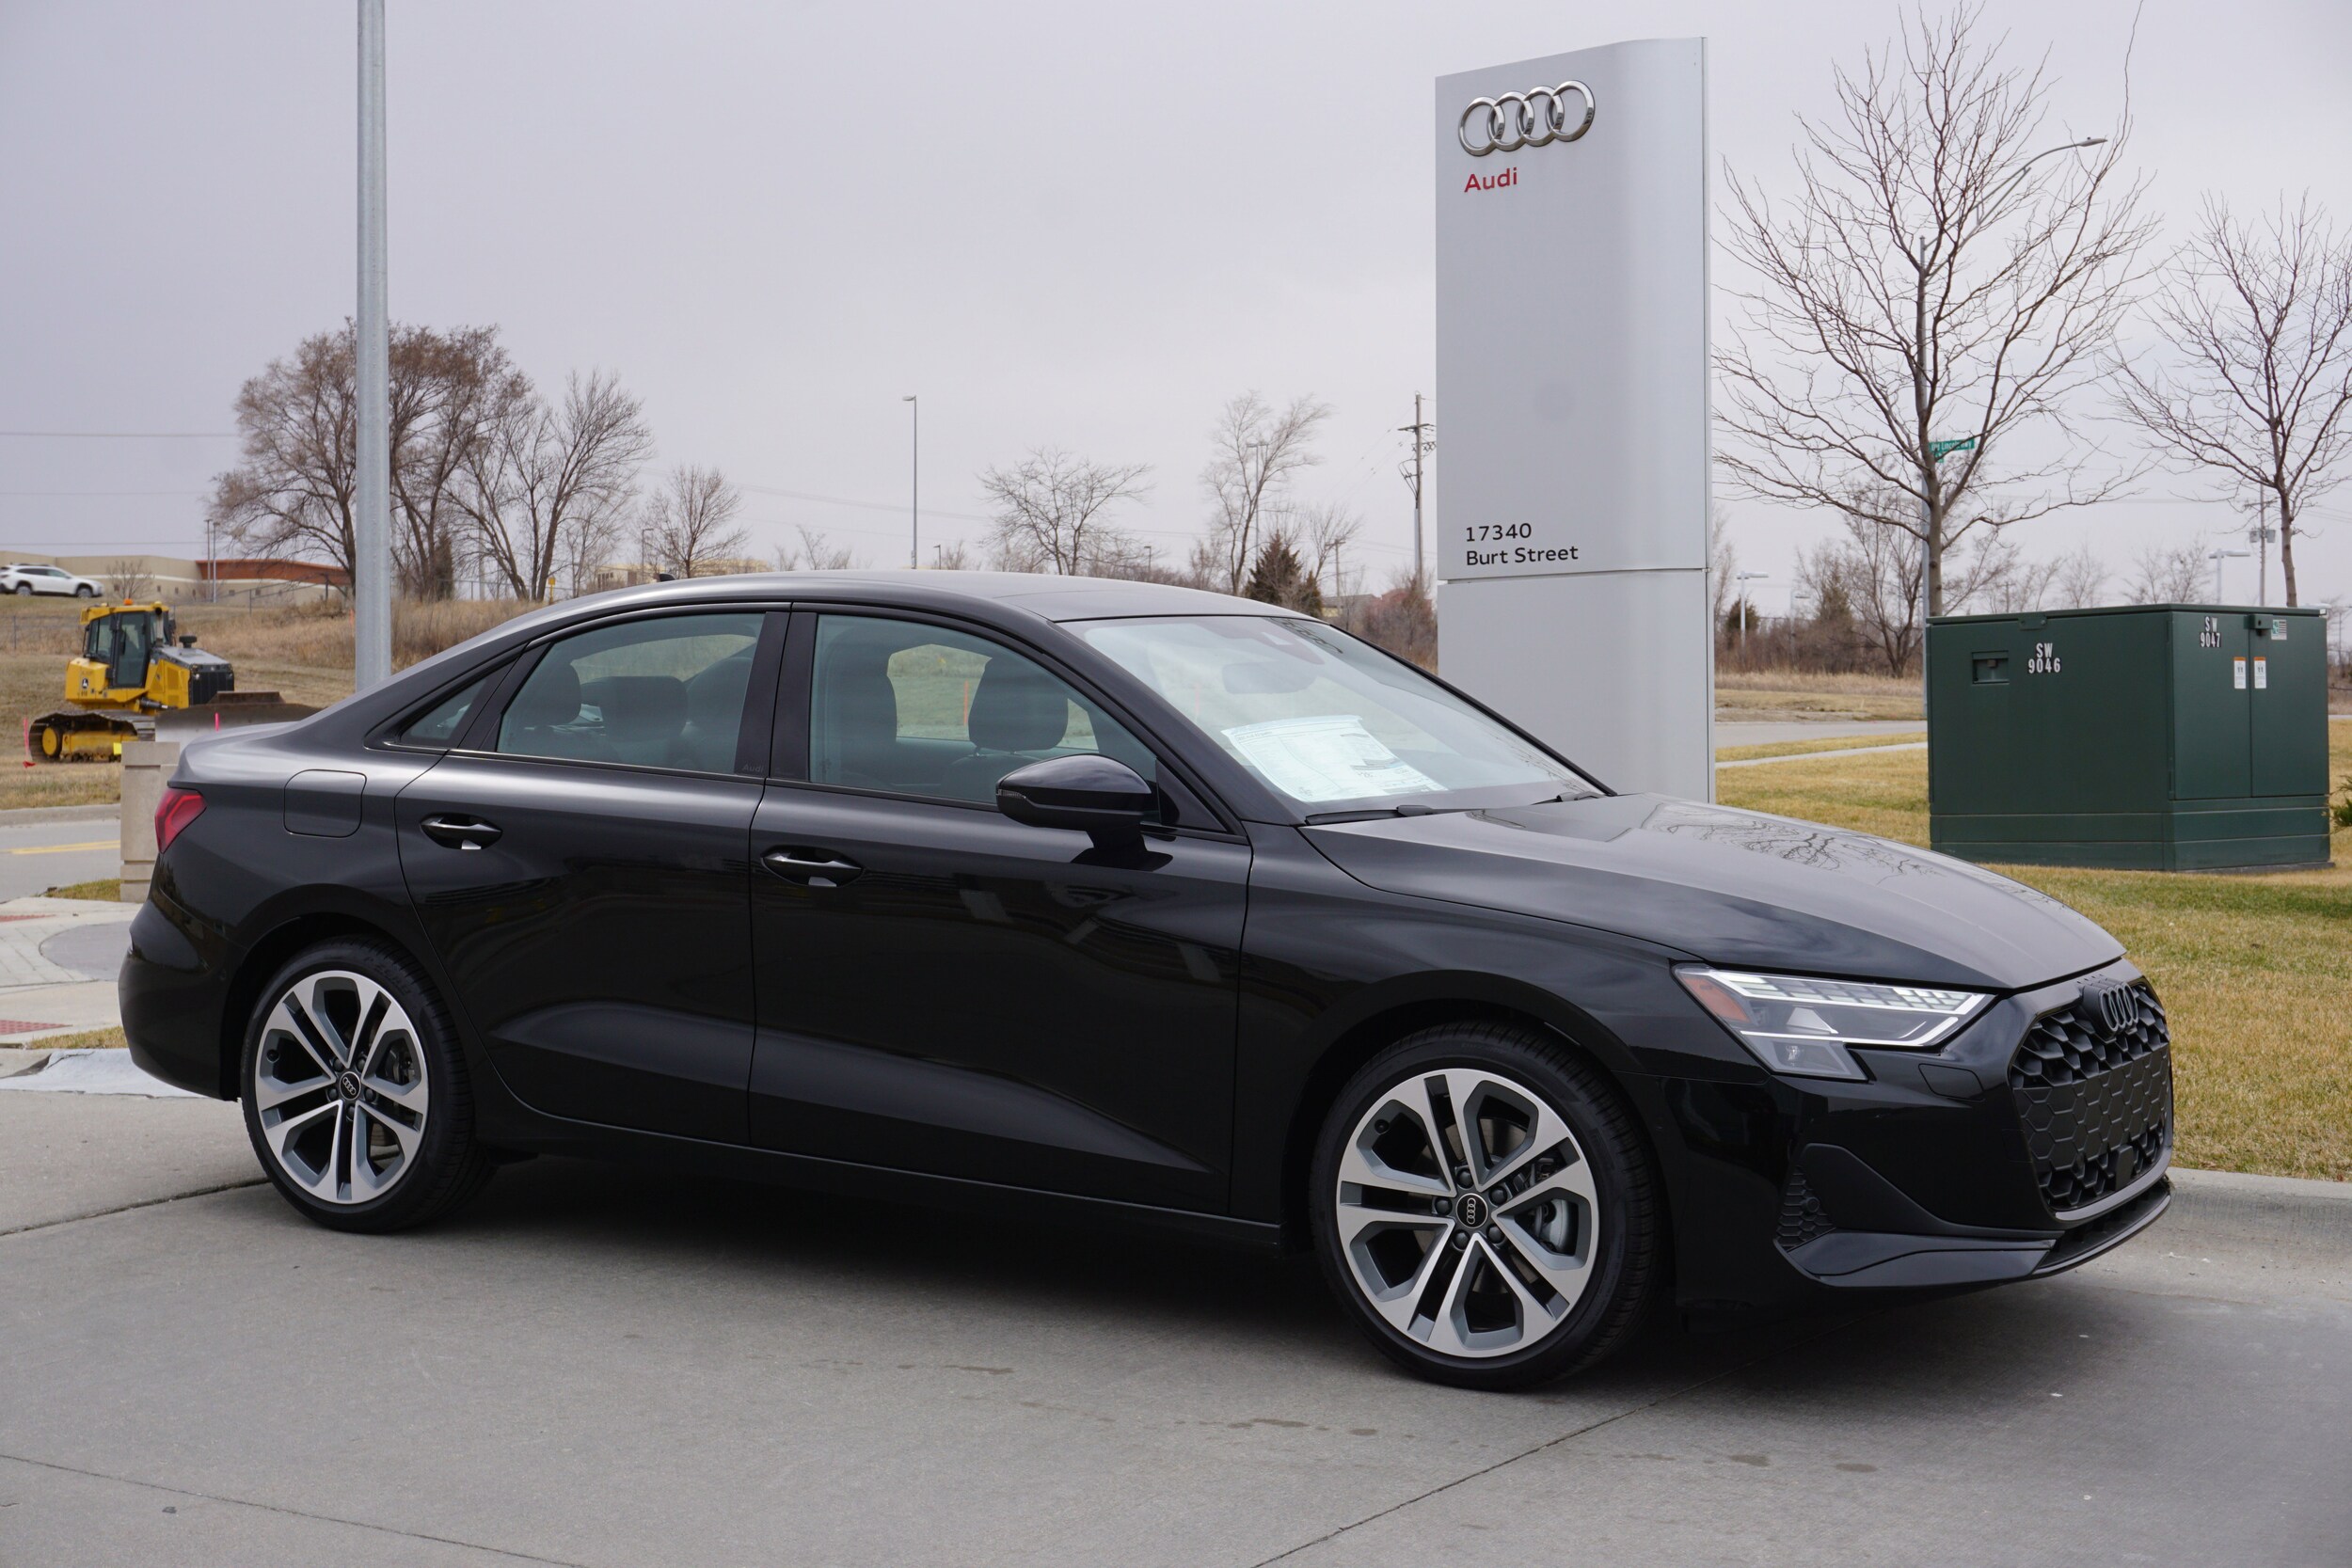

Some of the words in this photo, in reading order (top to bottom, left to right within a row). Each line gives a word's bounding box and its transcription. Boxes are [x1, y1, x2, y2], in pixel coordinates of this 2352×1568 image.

[1464, 167, 1518, 192] Audi
[1466, 523, 1532, 542] 17340
[1467, 550, 1508, 565] Burt
[1515, 546, 1578, 563] Street
[2204, 616, 2217, 632] SW
[2200, 633, 2220, 648] 9047
[2035, 642, 2053, 657] SW
[2027, 657, 2061, 673] 9046
